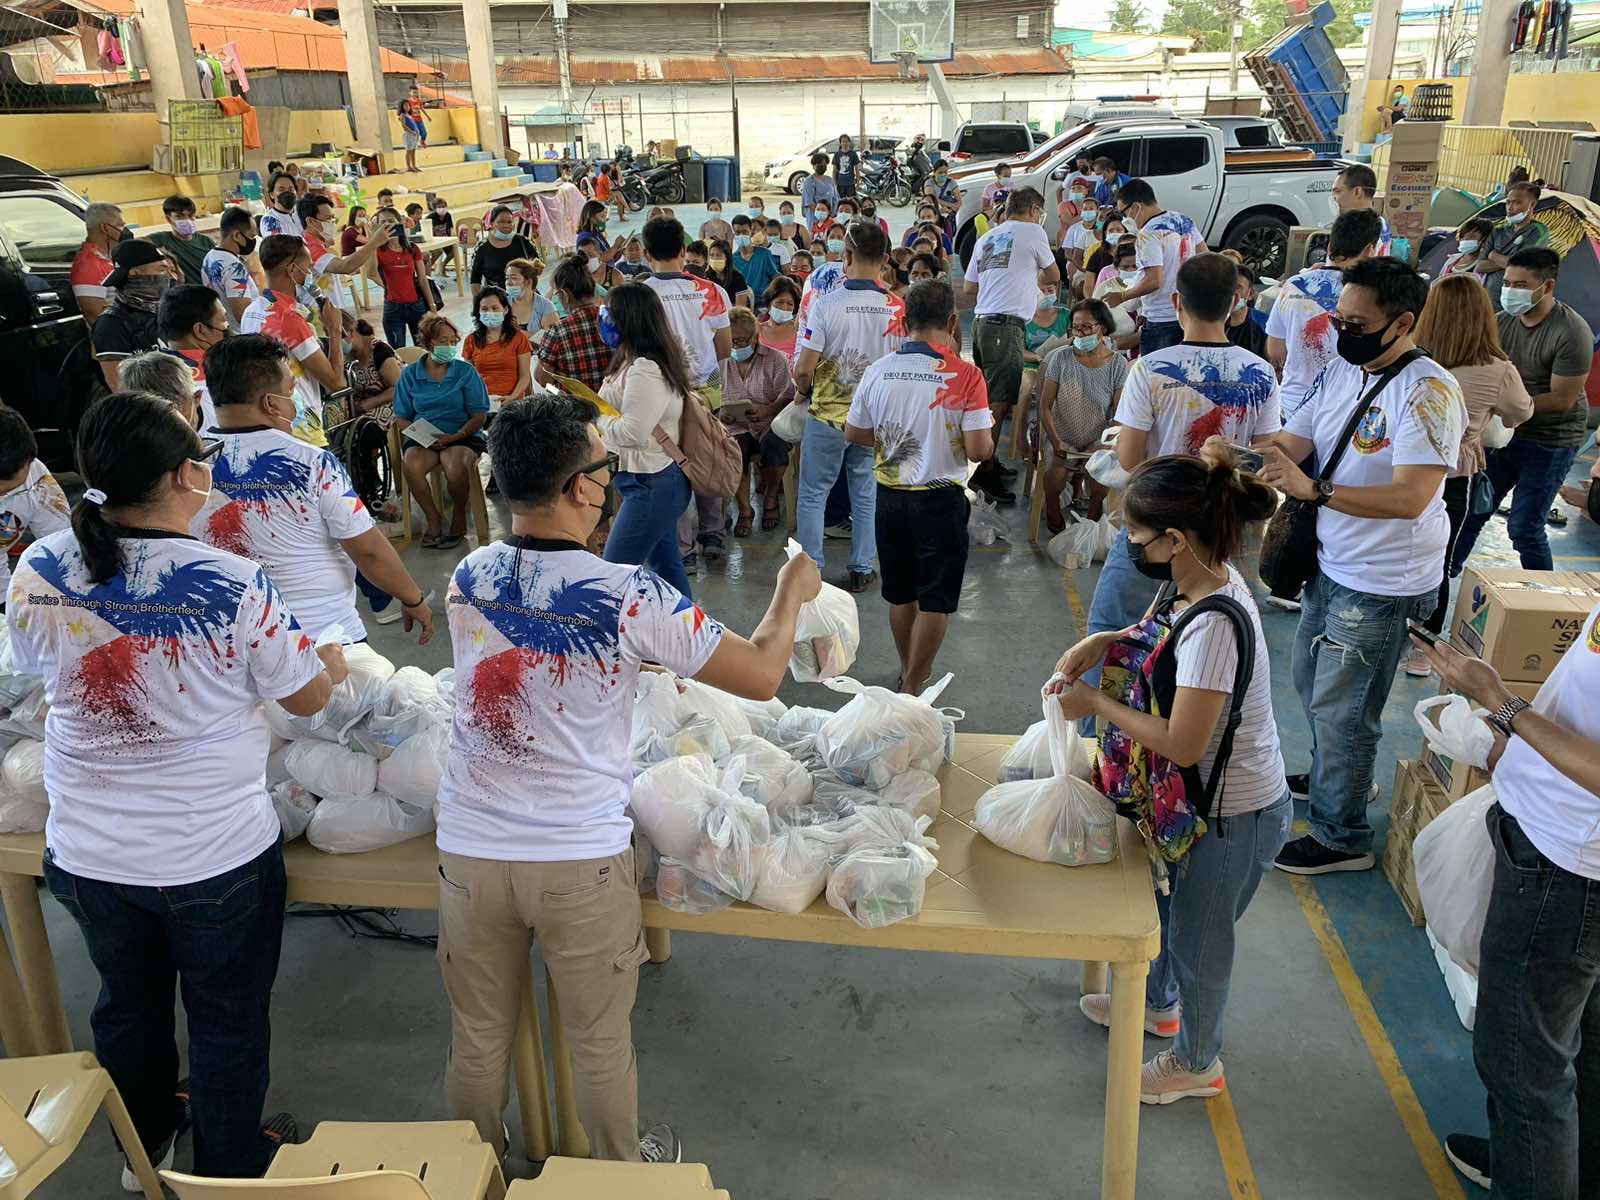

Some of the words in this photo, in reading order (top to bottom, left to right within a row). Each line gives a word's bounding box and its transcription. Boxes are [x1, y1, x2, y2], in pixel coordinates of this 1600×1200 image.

[913, 372, 943, 381] PATRIA
[28, 593, 59, 605] Service
[60, 595, 102, 610] Through
[104, 600, 138, 614] Strong
[140, 602, 206, 616] Brotherhood
[470, 597, 501, 611] Through
[503, 602, 532, 617] Strong
[534, 608, 595, 627] Brotherhood
